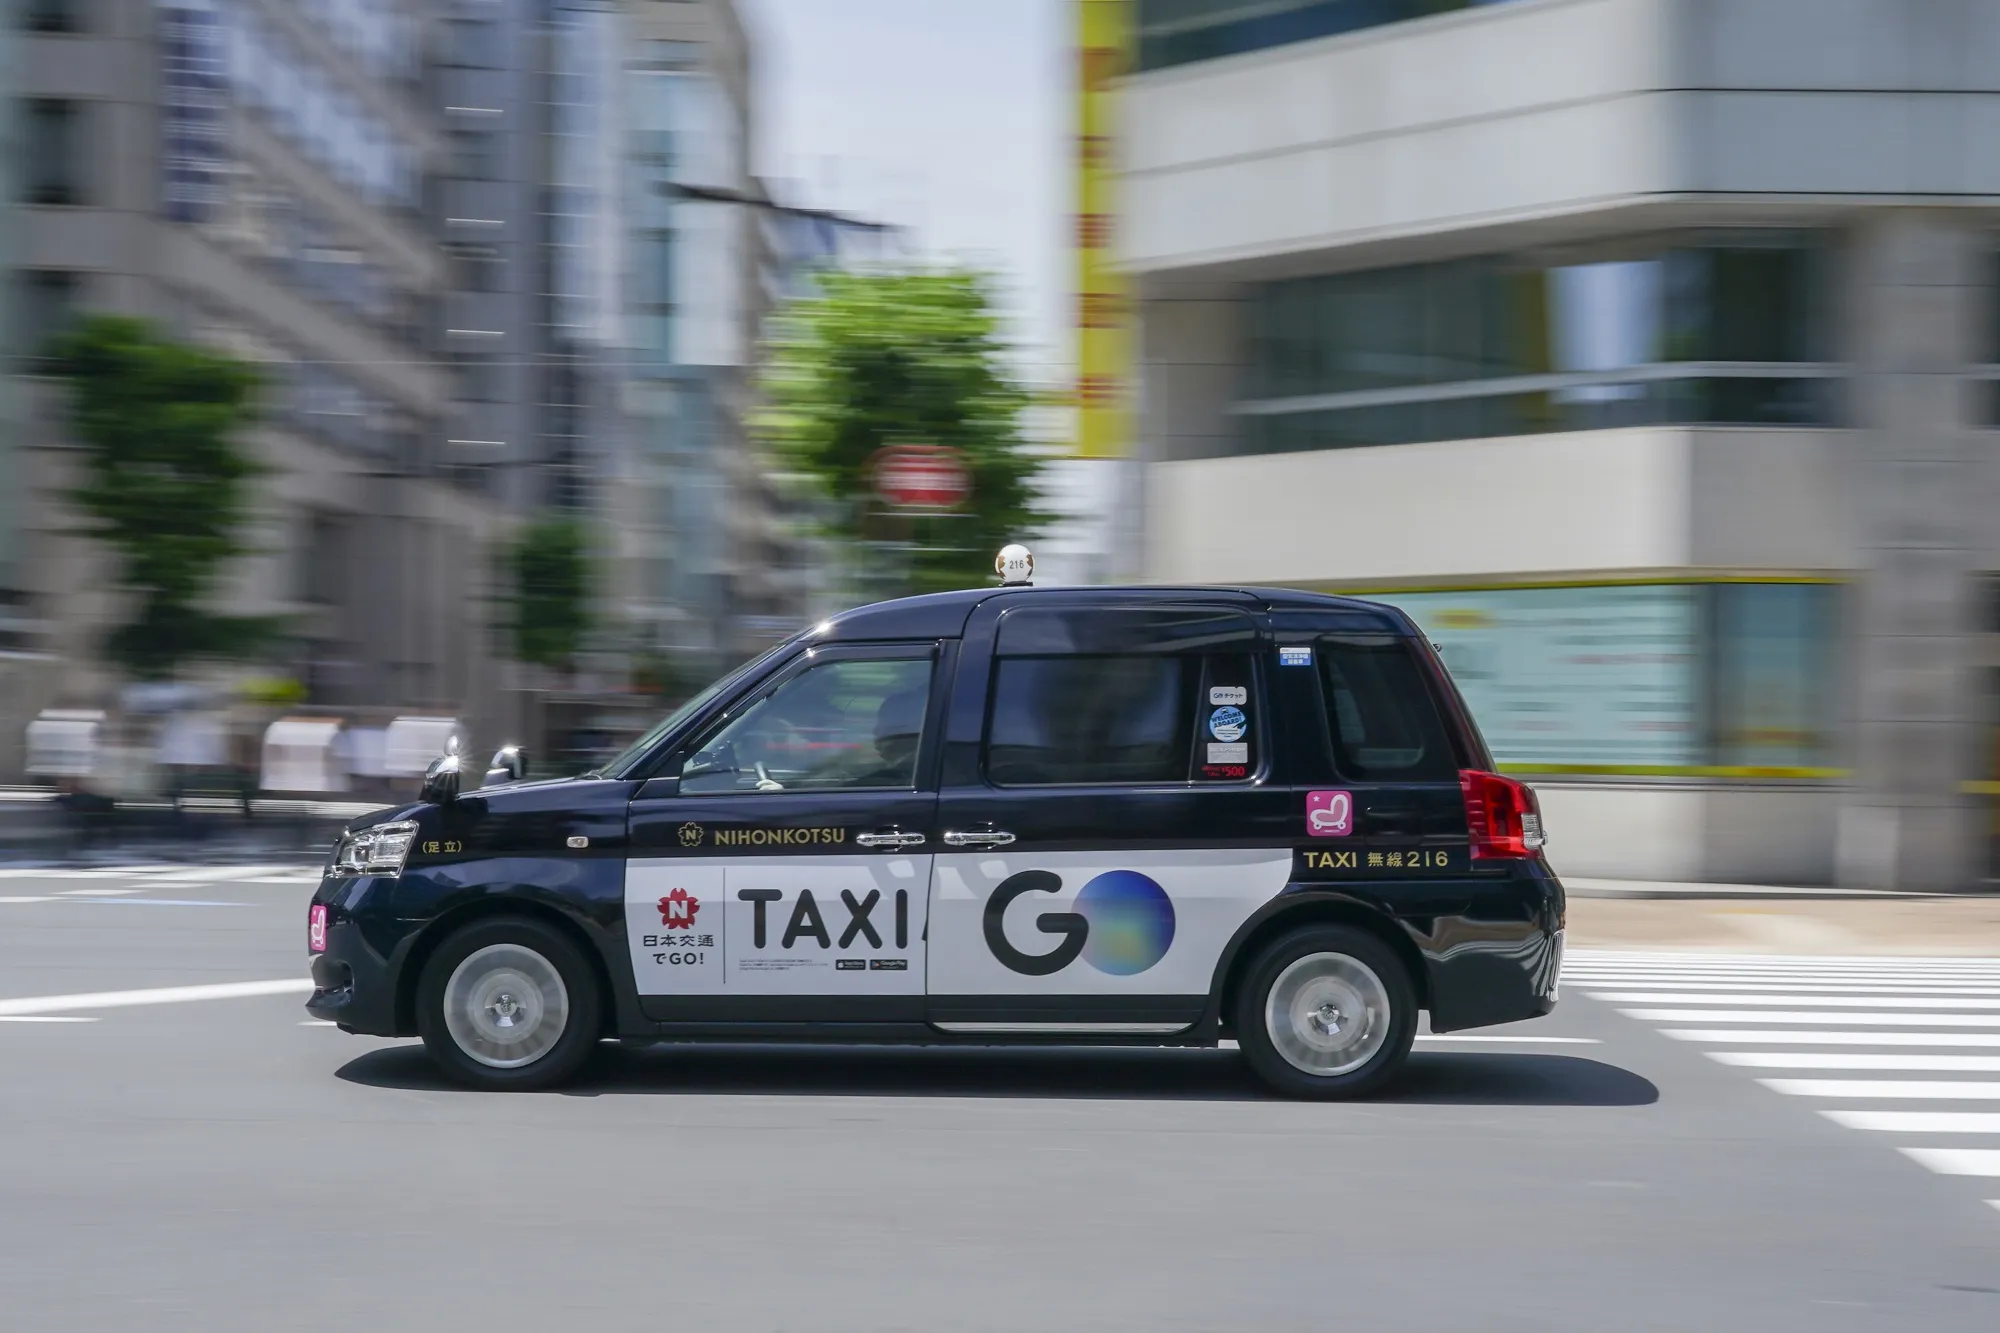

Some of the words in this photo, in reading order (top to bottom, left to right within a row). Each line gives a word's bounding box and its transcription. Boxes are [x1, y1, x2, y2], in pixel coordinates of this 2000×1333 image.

[1009, 560, 1025, 569] 216
[1211, 711, 1242, 723] WELCOME
[715, 828, 845, 845] NIHONKOTSU
[1303, 852, 1357, 868] TAXI
[737, 888, 908, 949] TAXI
[983, 870, 1176, 976] GO
[643, 934, 714, 947] 日本交通
[653, 952, 704, 965] でGO!
